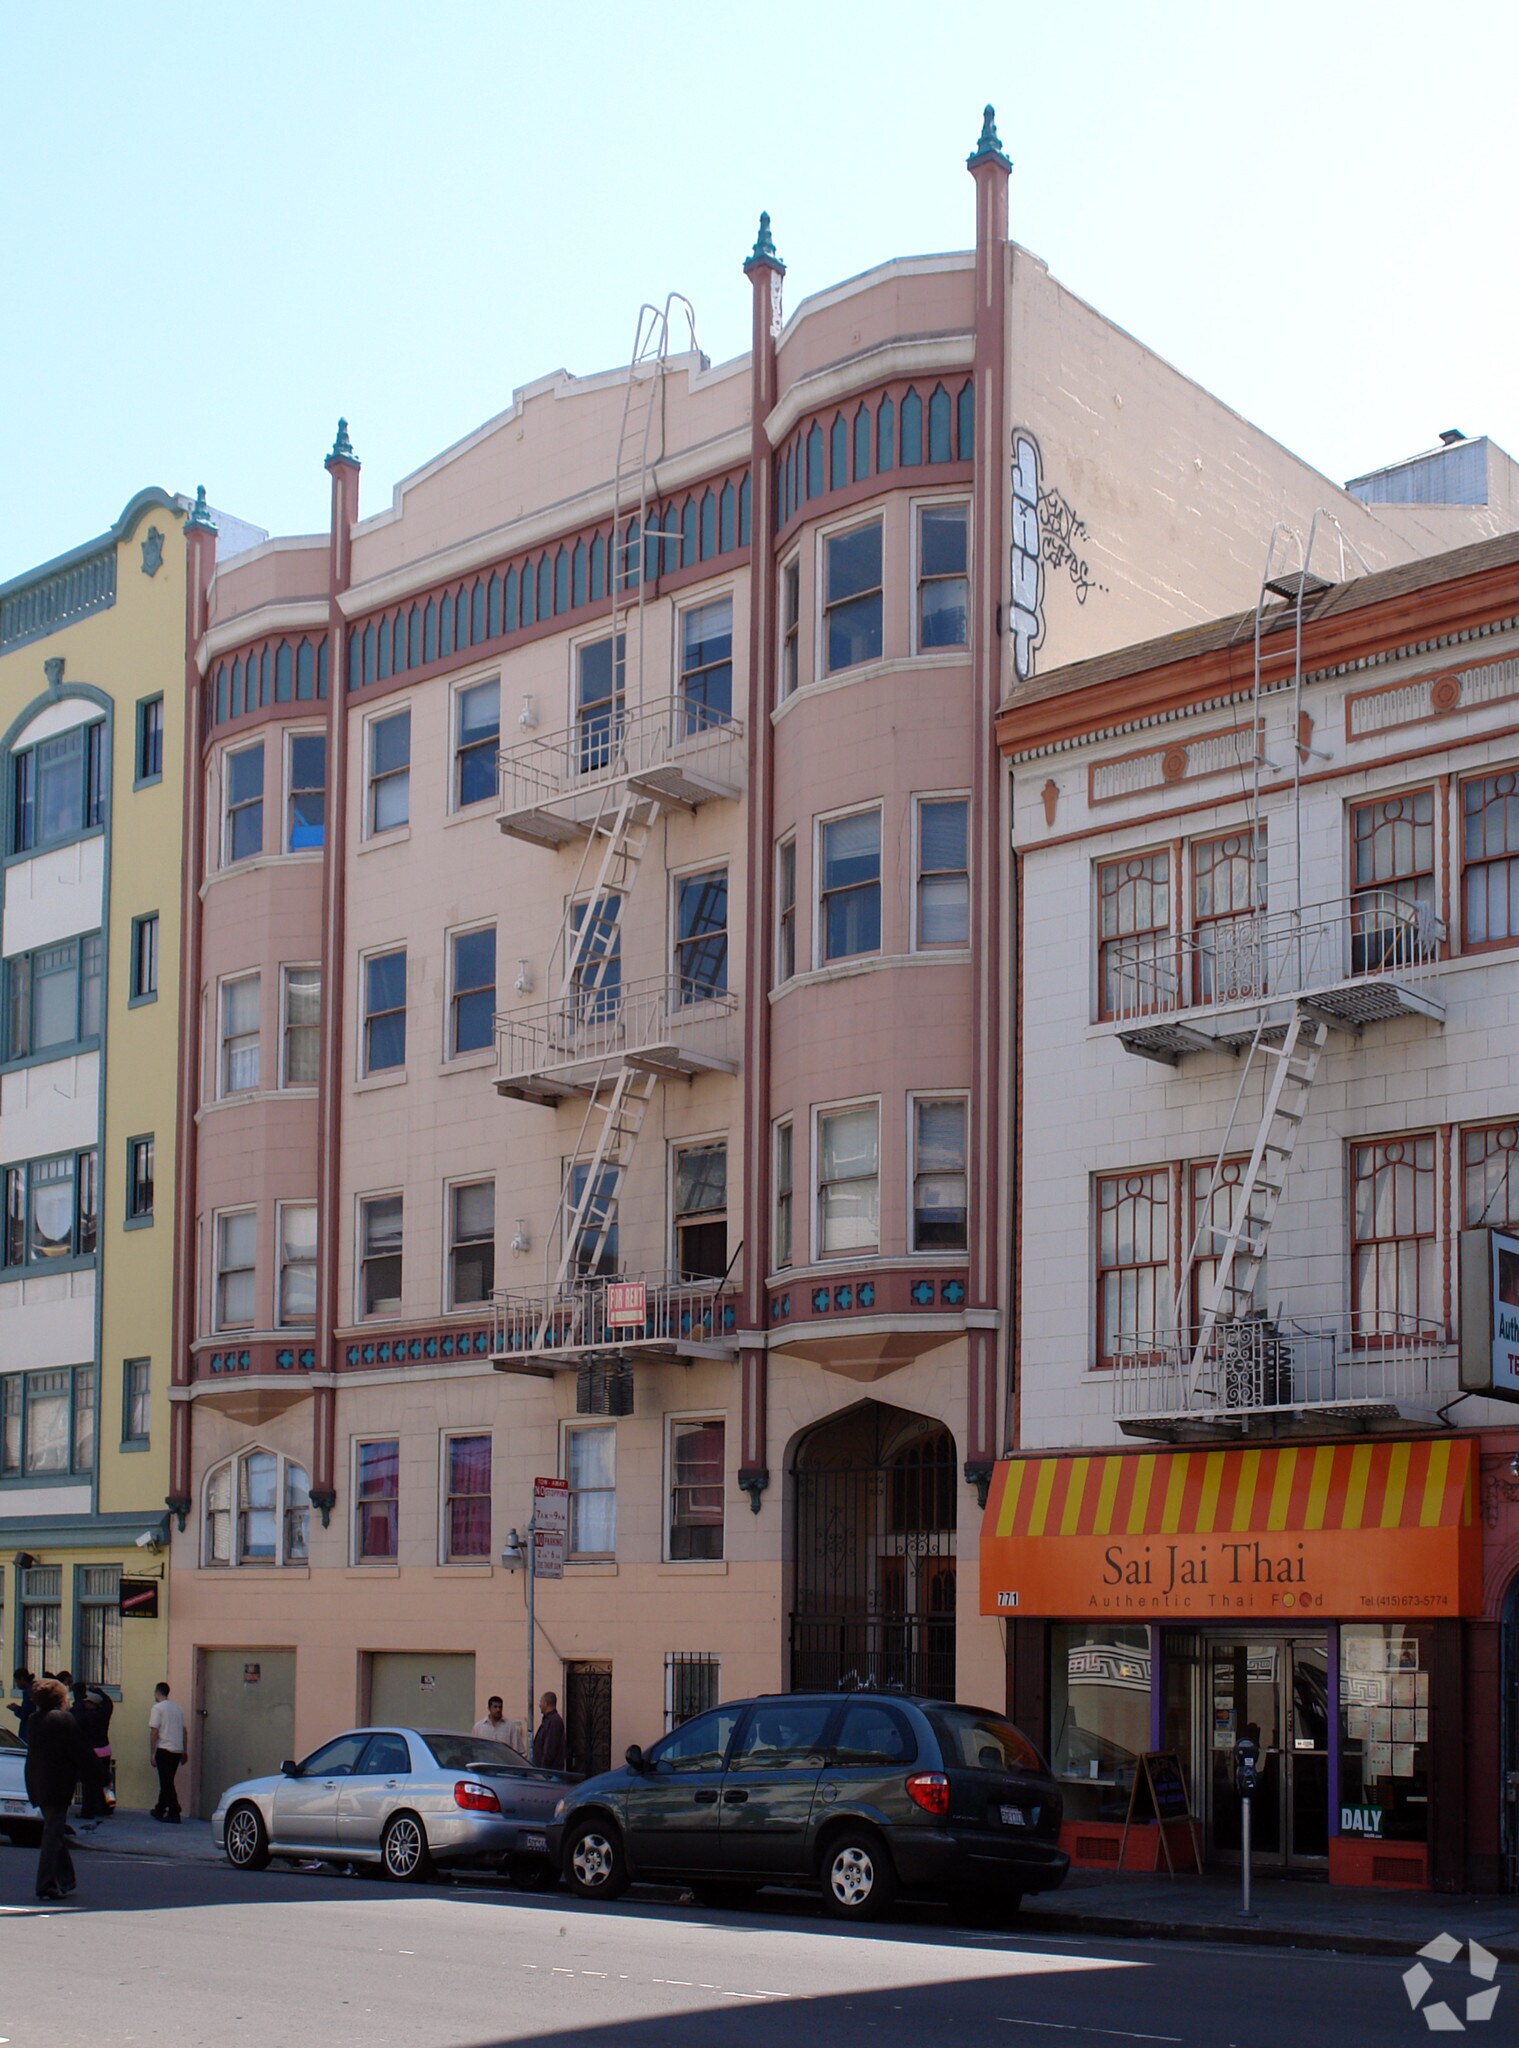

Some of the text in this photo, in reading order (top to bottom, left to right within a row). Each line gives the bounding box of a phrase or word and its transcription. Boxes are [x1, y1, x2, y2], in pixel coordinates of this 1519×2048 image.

[625, 1286, 643, 1308] RENT
[1102, 1541, 1307, 1595] Sai Jai Thai
[998, 1592, 1018, 1606] 771
[1088, 1594, 1192, 1607] Authentic
[1208, 1593, 1254, 1607] Thai
[1341, 1808, 1383, 1832] DALY
